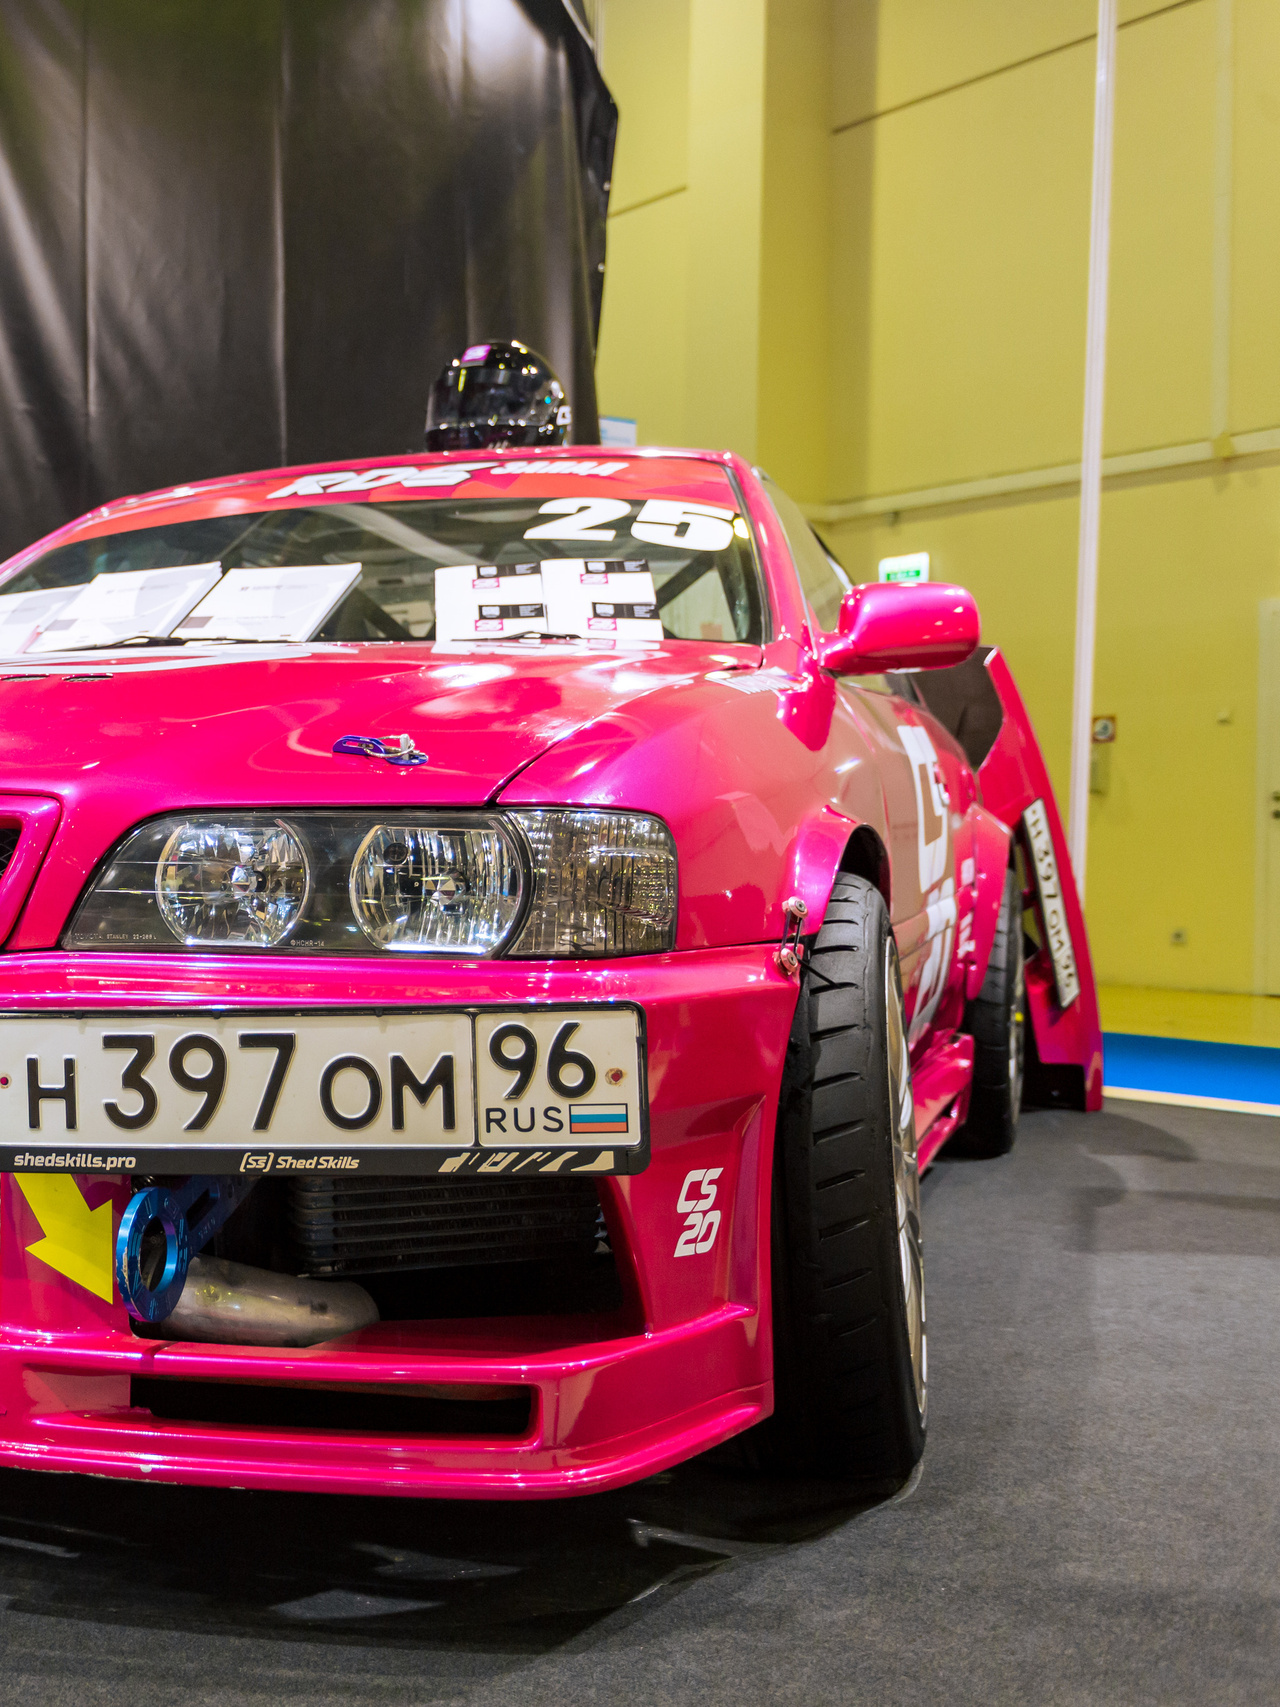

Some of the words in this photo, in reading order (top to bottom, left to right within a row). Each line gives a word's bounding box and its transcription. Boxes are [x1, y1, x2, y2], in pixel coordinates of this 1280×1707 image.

[523, 498, 735, 552] 25
[488, 1021, 597, 1101] 96
[485, 1106, 565, 1134] RUS
[14, 1152, 137, 1171] shedskills.pro
[676, 1167, 724, 1214] CS
[673, 1210, 721, 1258] 20
